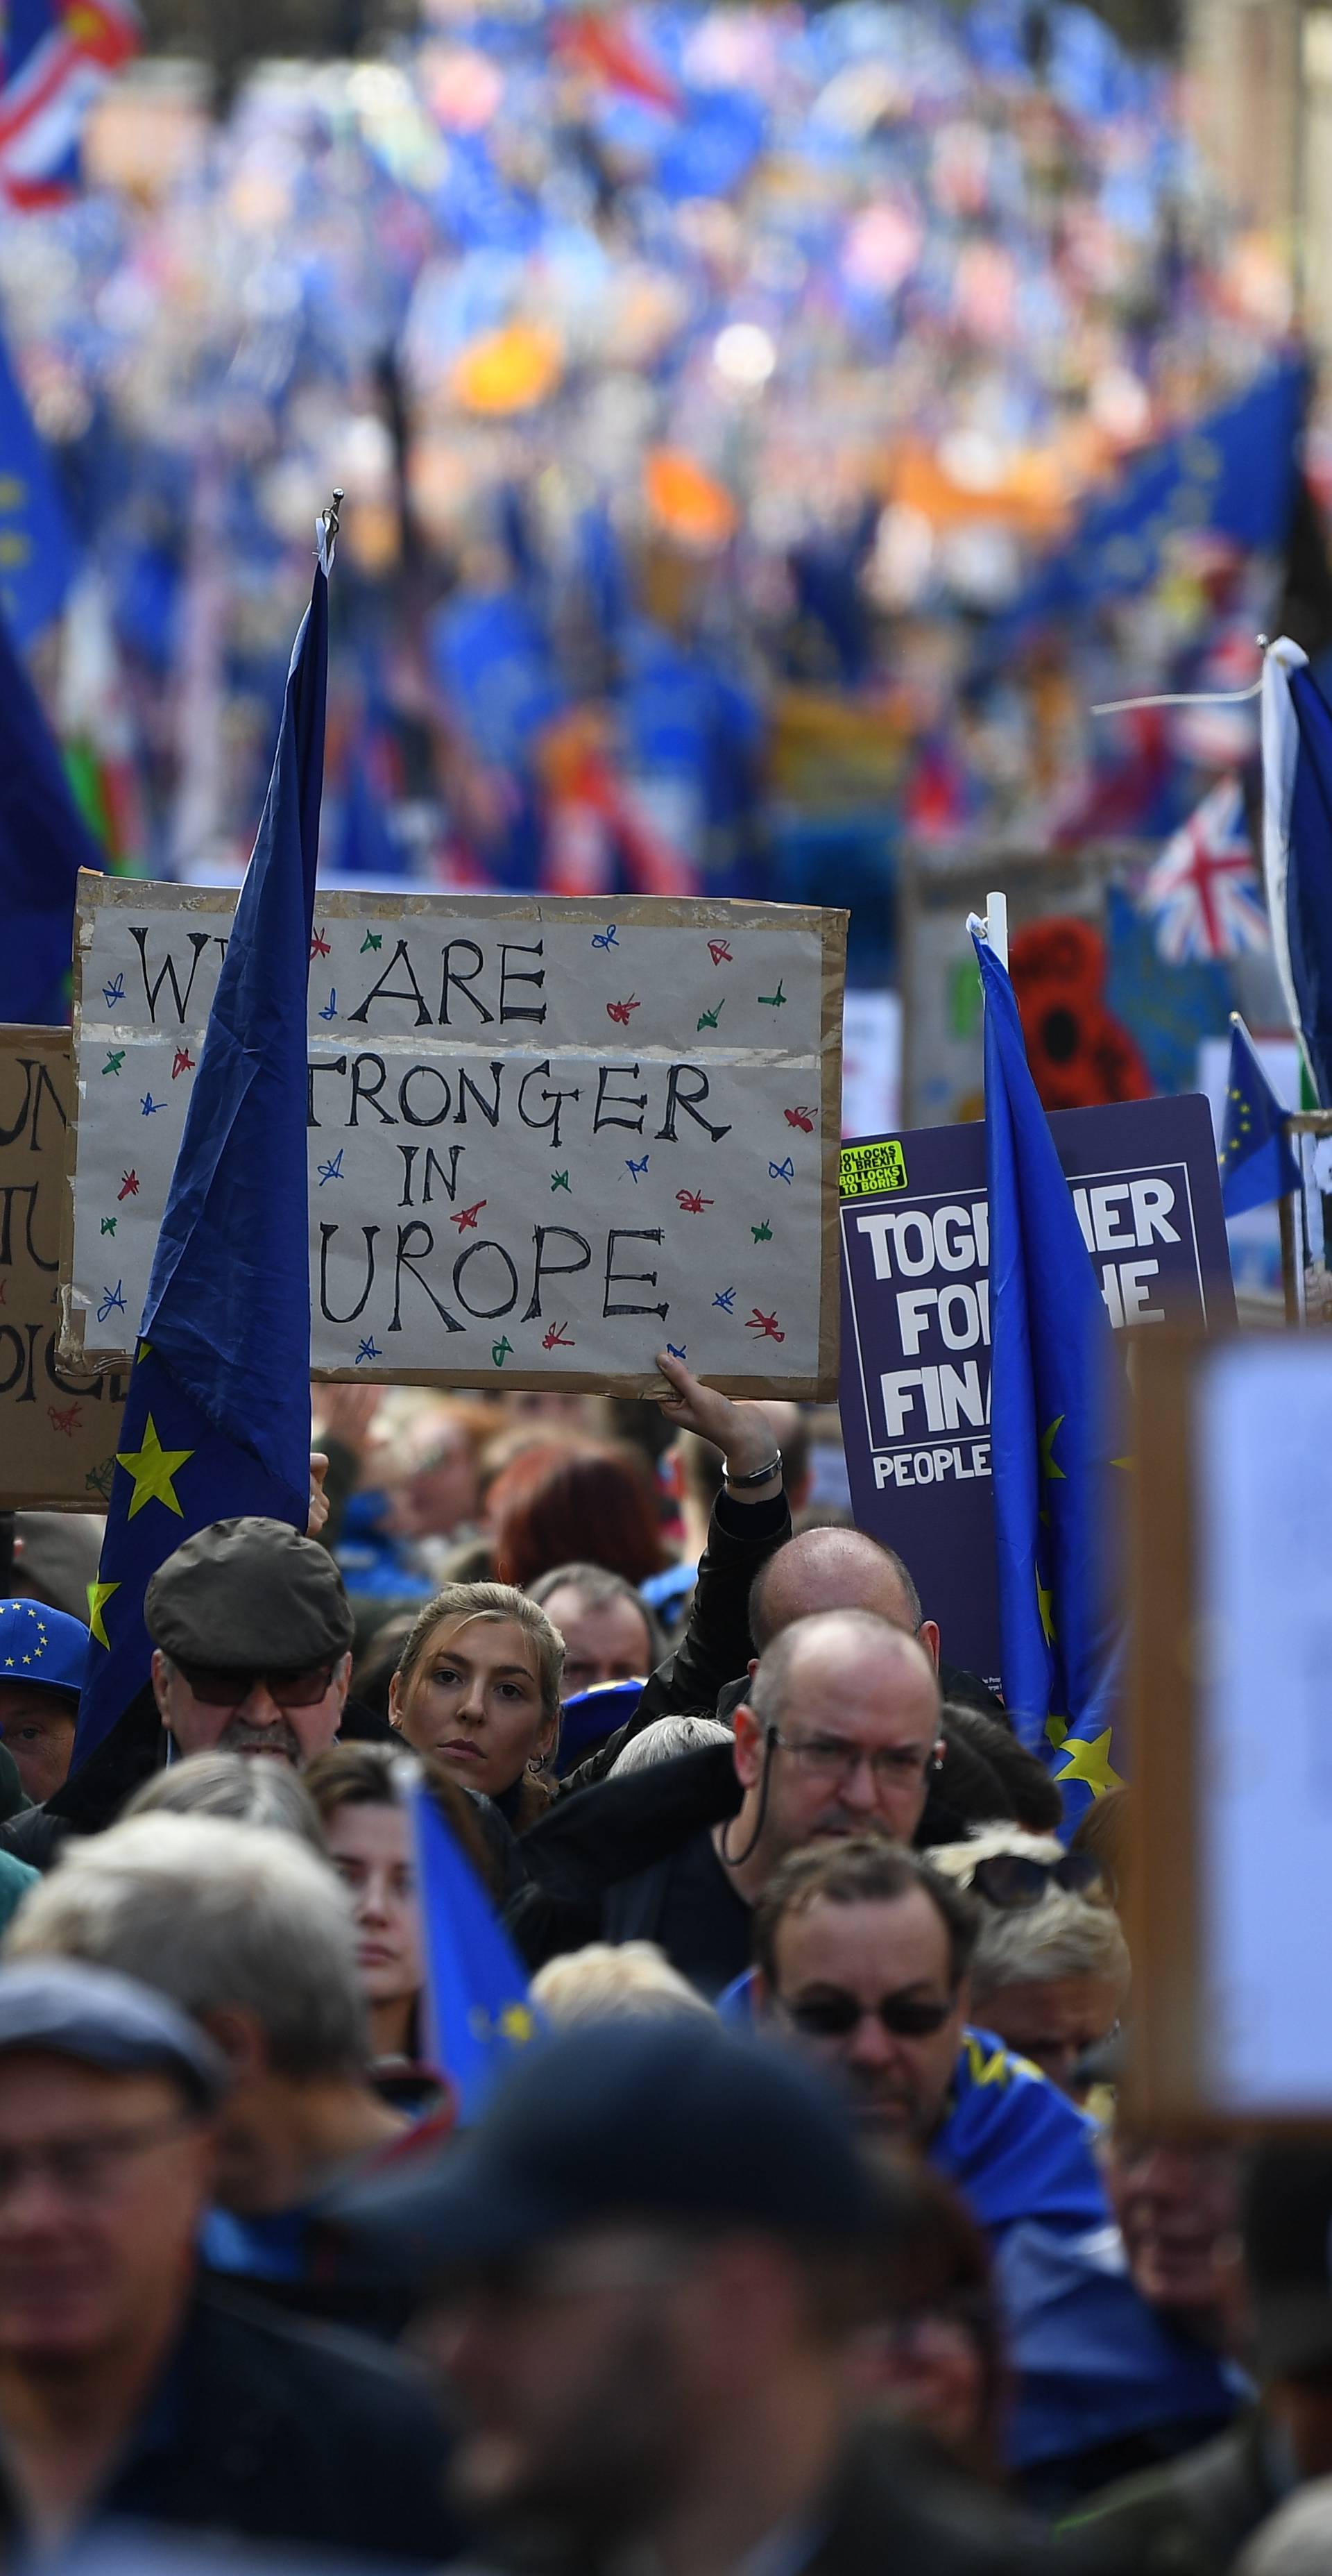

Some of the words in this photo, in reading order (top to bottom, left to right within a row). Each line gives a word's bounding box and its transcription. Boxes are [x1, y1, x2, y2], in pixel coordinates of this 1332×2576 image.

[128, 926, 228, 1024] W
[348, 938, 547, 1026] ARE
[307, 1052, 733, 1147] TRONGER
[398, 1144, 466, 1207] IN
[839, 1145, 896, 1164] OLLOCKS
[839, 1166, 900, 1186] BOLLOCKS
[842, 1183, 858, 1194] TO
[861, 1176, 899, 1192] BORIS
[855, 1155, 896, 1171] BREXIT
[319, 1220, 670, 1333] UROPE
[880, 1360, 992, 1437] FIN
